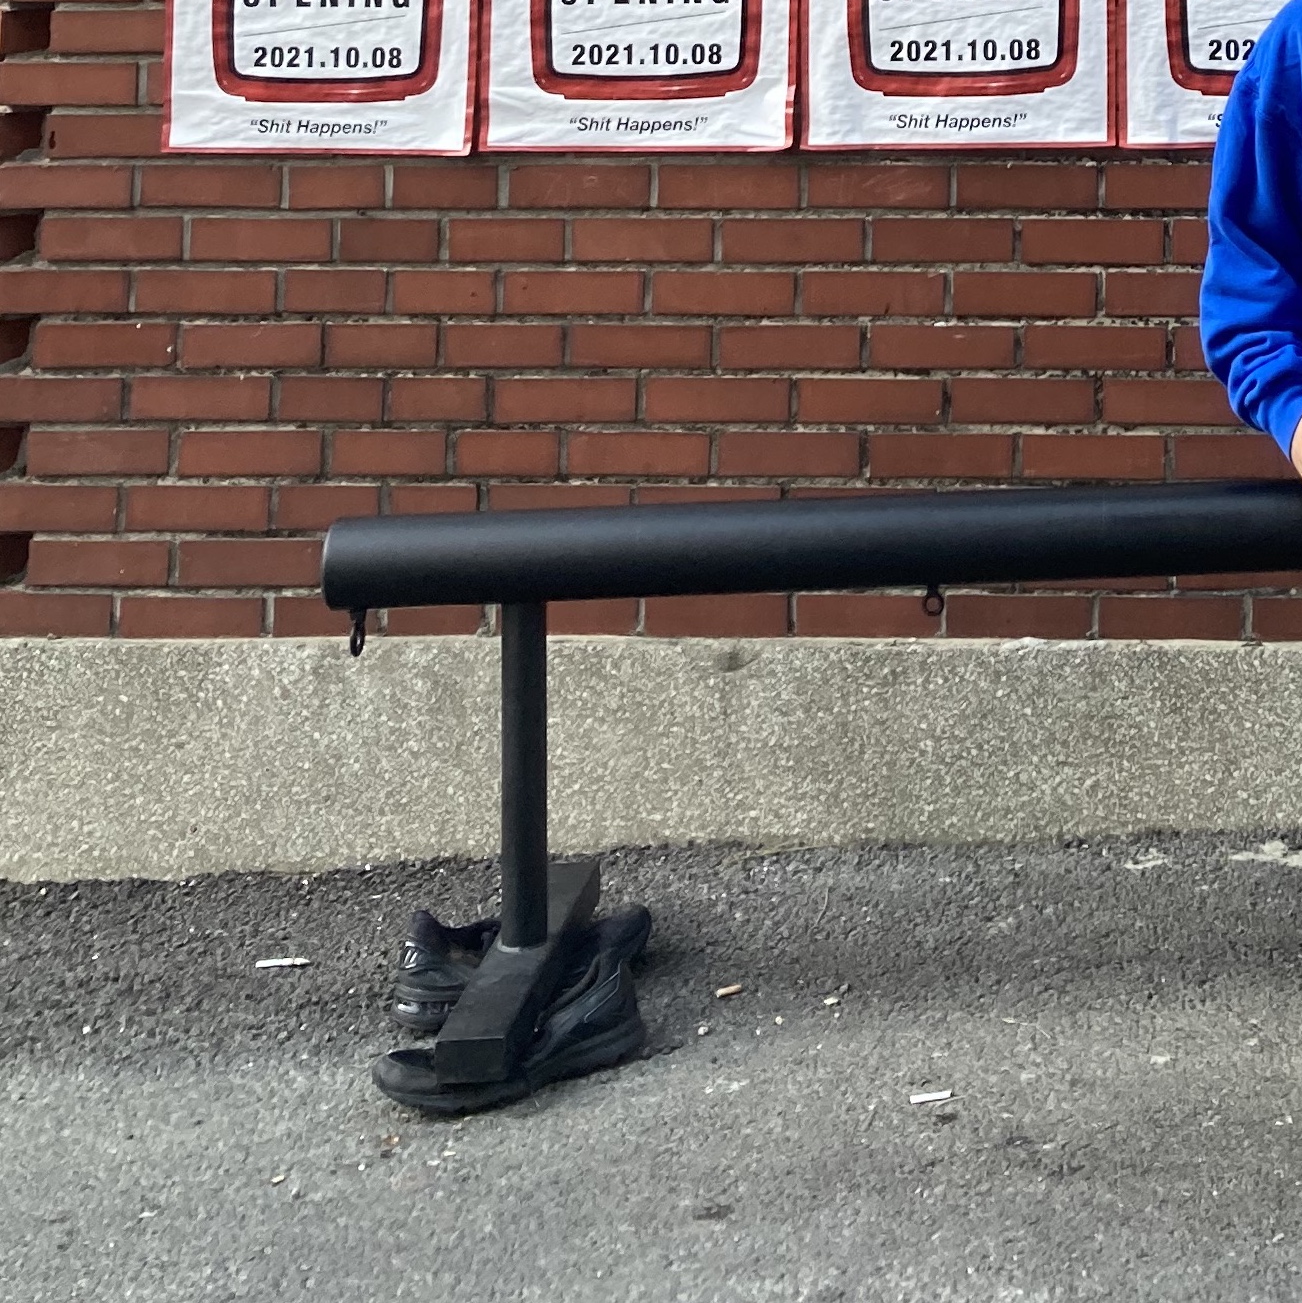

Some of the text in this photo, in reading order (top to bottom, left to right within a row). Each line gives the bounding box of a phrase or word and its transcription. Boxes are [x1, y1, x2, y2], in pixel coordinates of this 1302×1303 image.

[254, 47, 401, 68] 2021.10.08
[572, 44, 721, 65] 2021.10.08
[891, 39, 1039, 61] 2021.10.08
